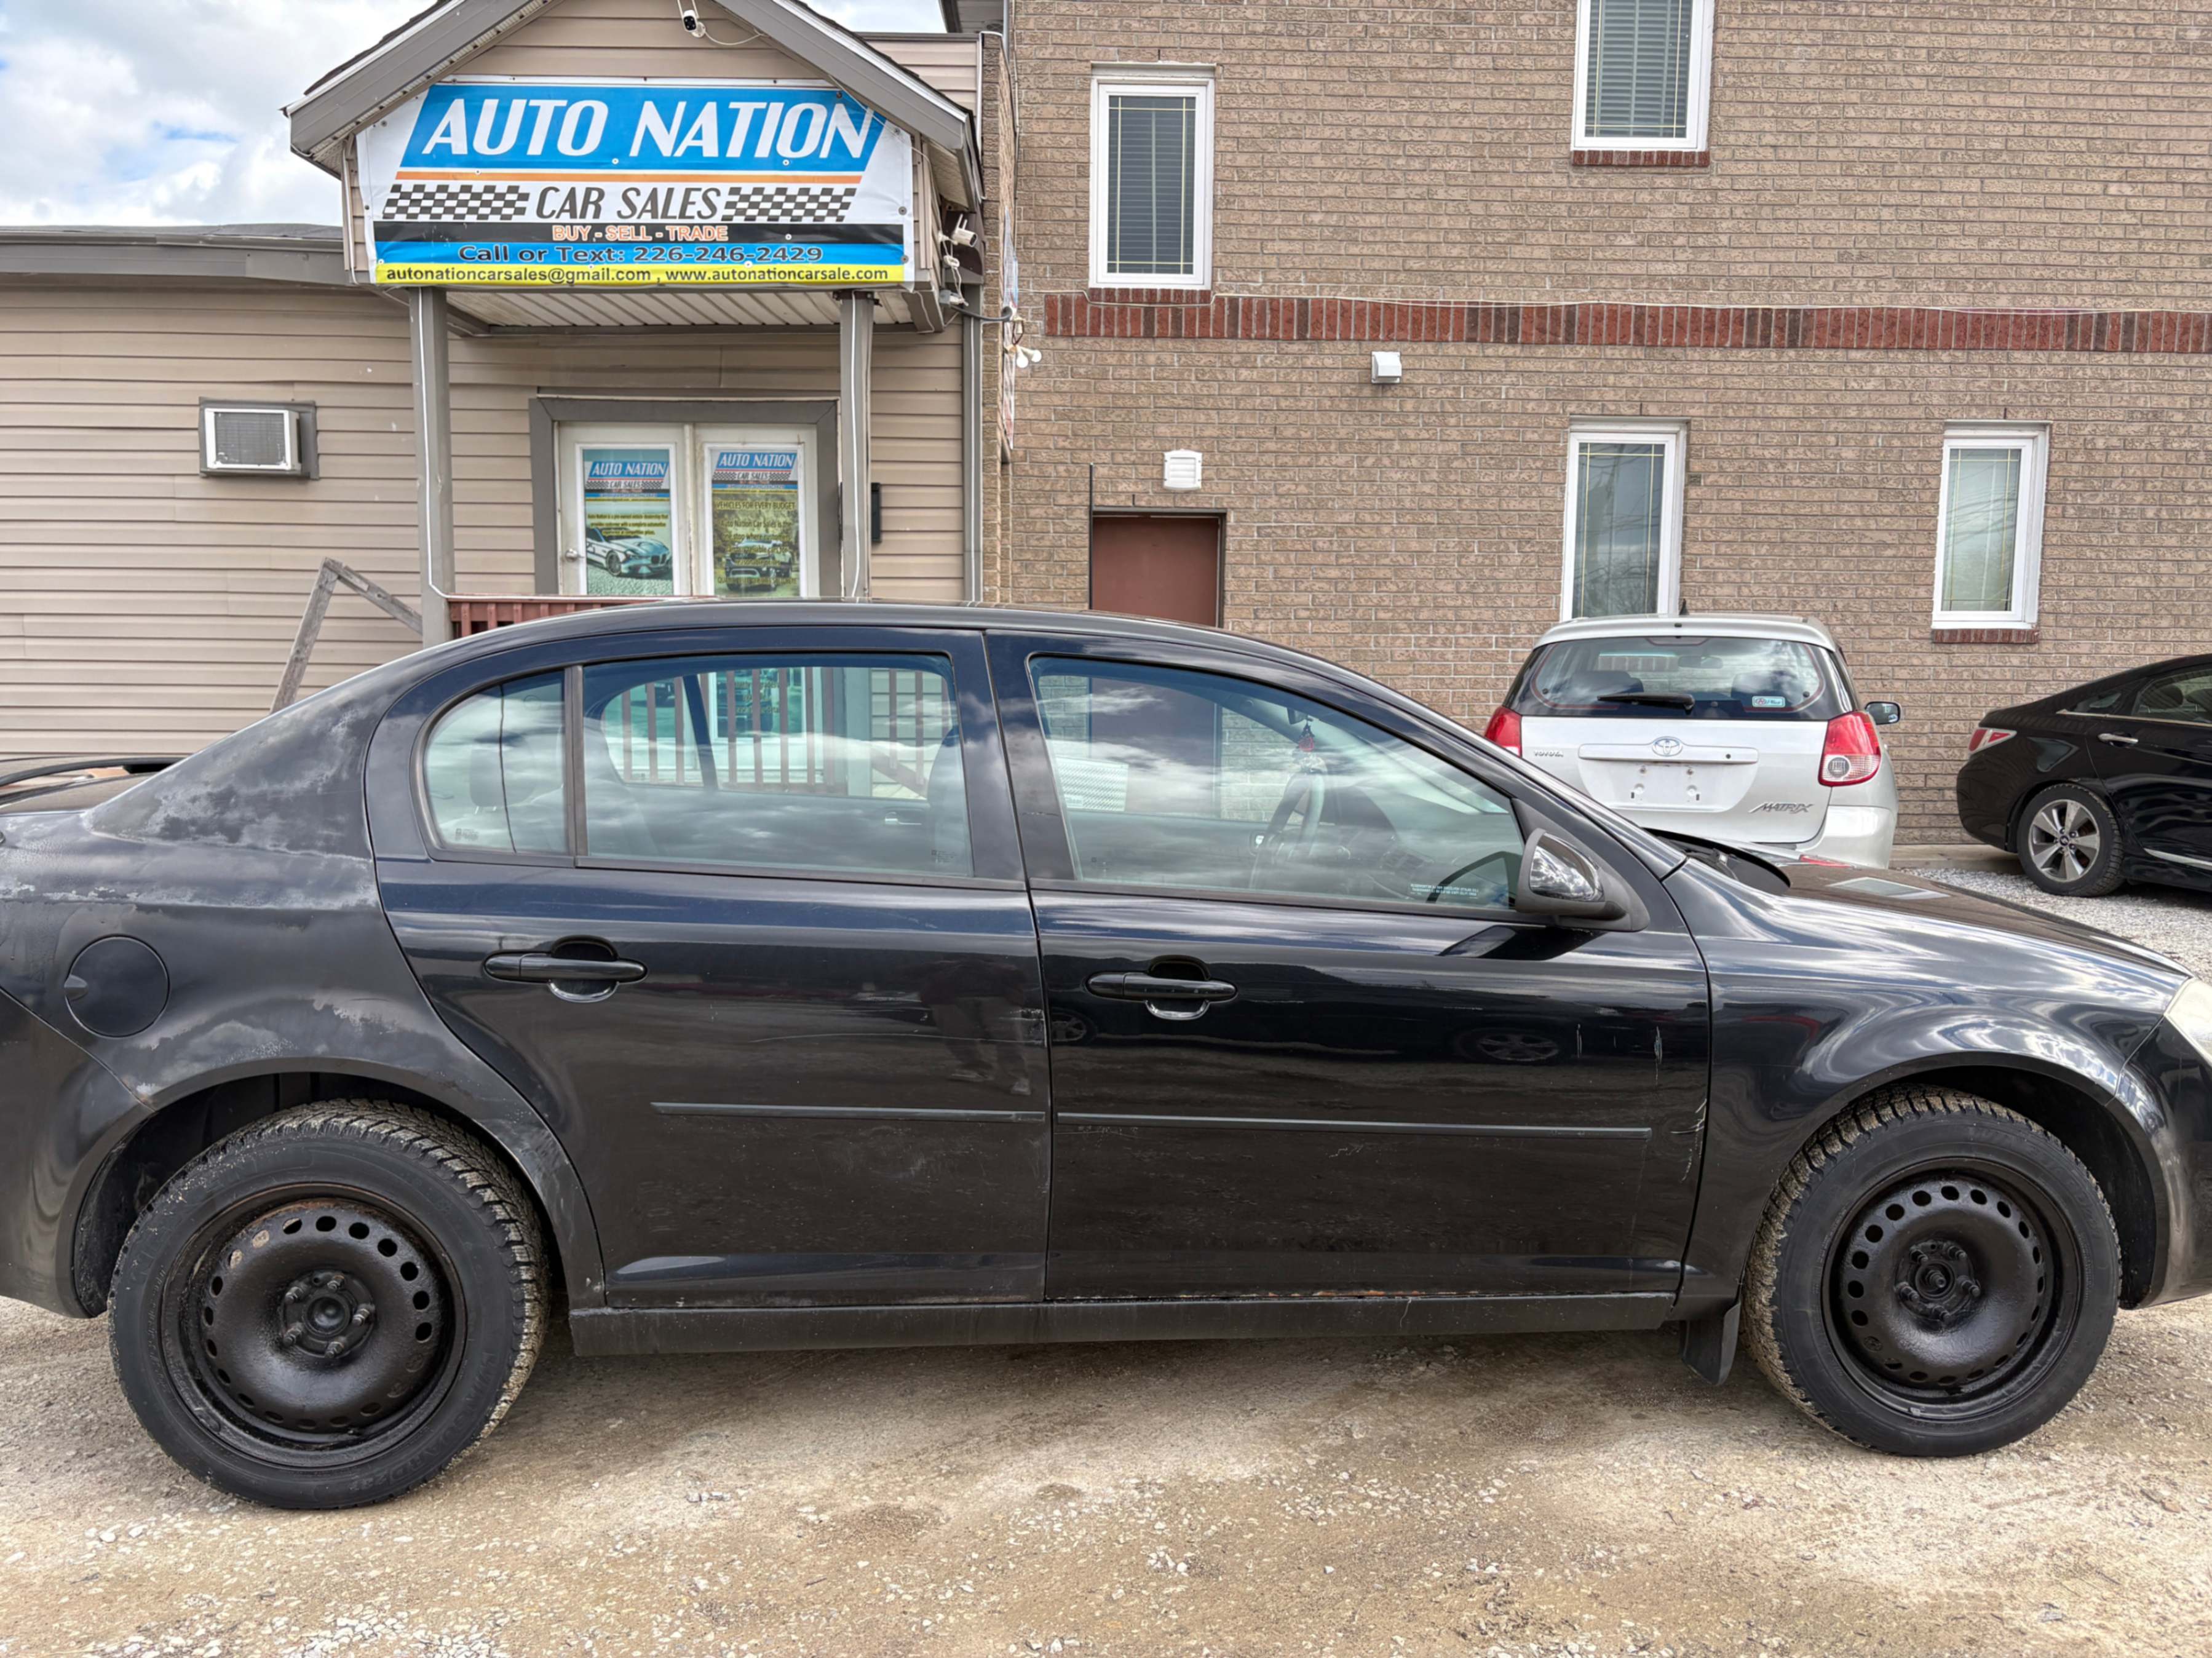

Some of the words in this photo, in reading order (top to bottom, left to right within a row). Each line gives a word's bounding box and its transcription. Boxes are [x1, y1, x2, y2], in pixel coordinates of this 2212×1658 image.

[422, 98, 608, 156] AUTO
[629, 100, 874, 159] NATION
[536, 186, 605, 220] CAR
[617, 187, 721, 221] SALES
[552, 225, 590, 241] BUY
[605, 225, 651, 241] SELL
[666, 225, 729, 241] TRADE
[458, 245, 510, 262] Call
[518, 248, 547, 262] or
[555, 246, 625, 263] Text:
[633, 246, 823, 262] 226-246-2429
[386, 268, 651, 285] autonationcarsales@gmail.com
[665, 268, 888, 281] www.autonationcarsale.com
[718, 453, 750, 467] AUTO
[752, 453, 795, 467] NATION
[592, 462, 623, 475] AUTO
[625, 462, 667, 475] NATION
[1747, 801, 1815, 814] MATRIX
